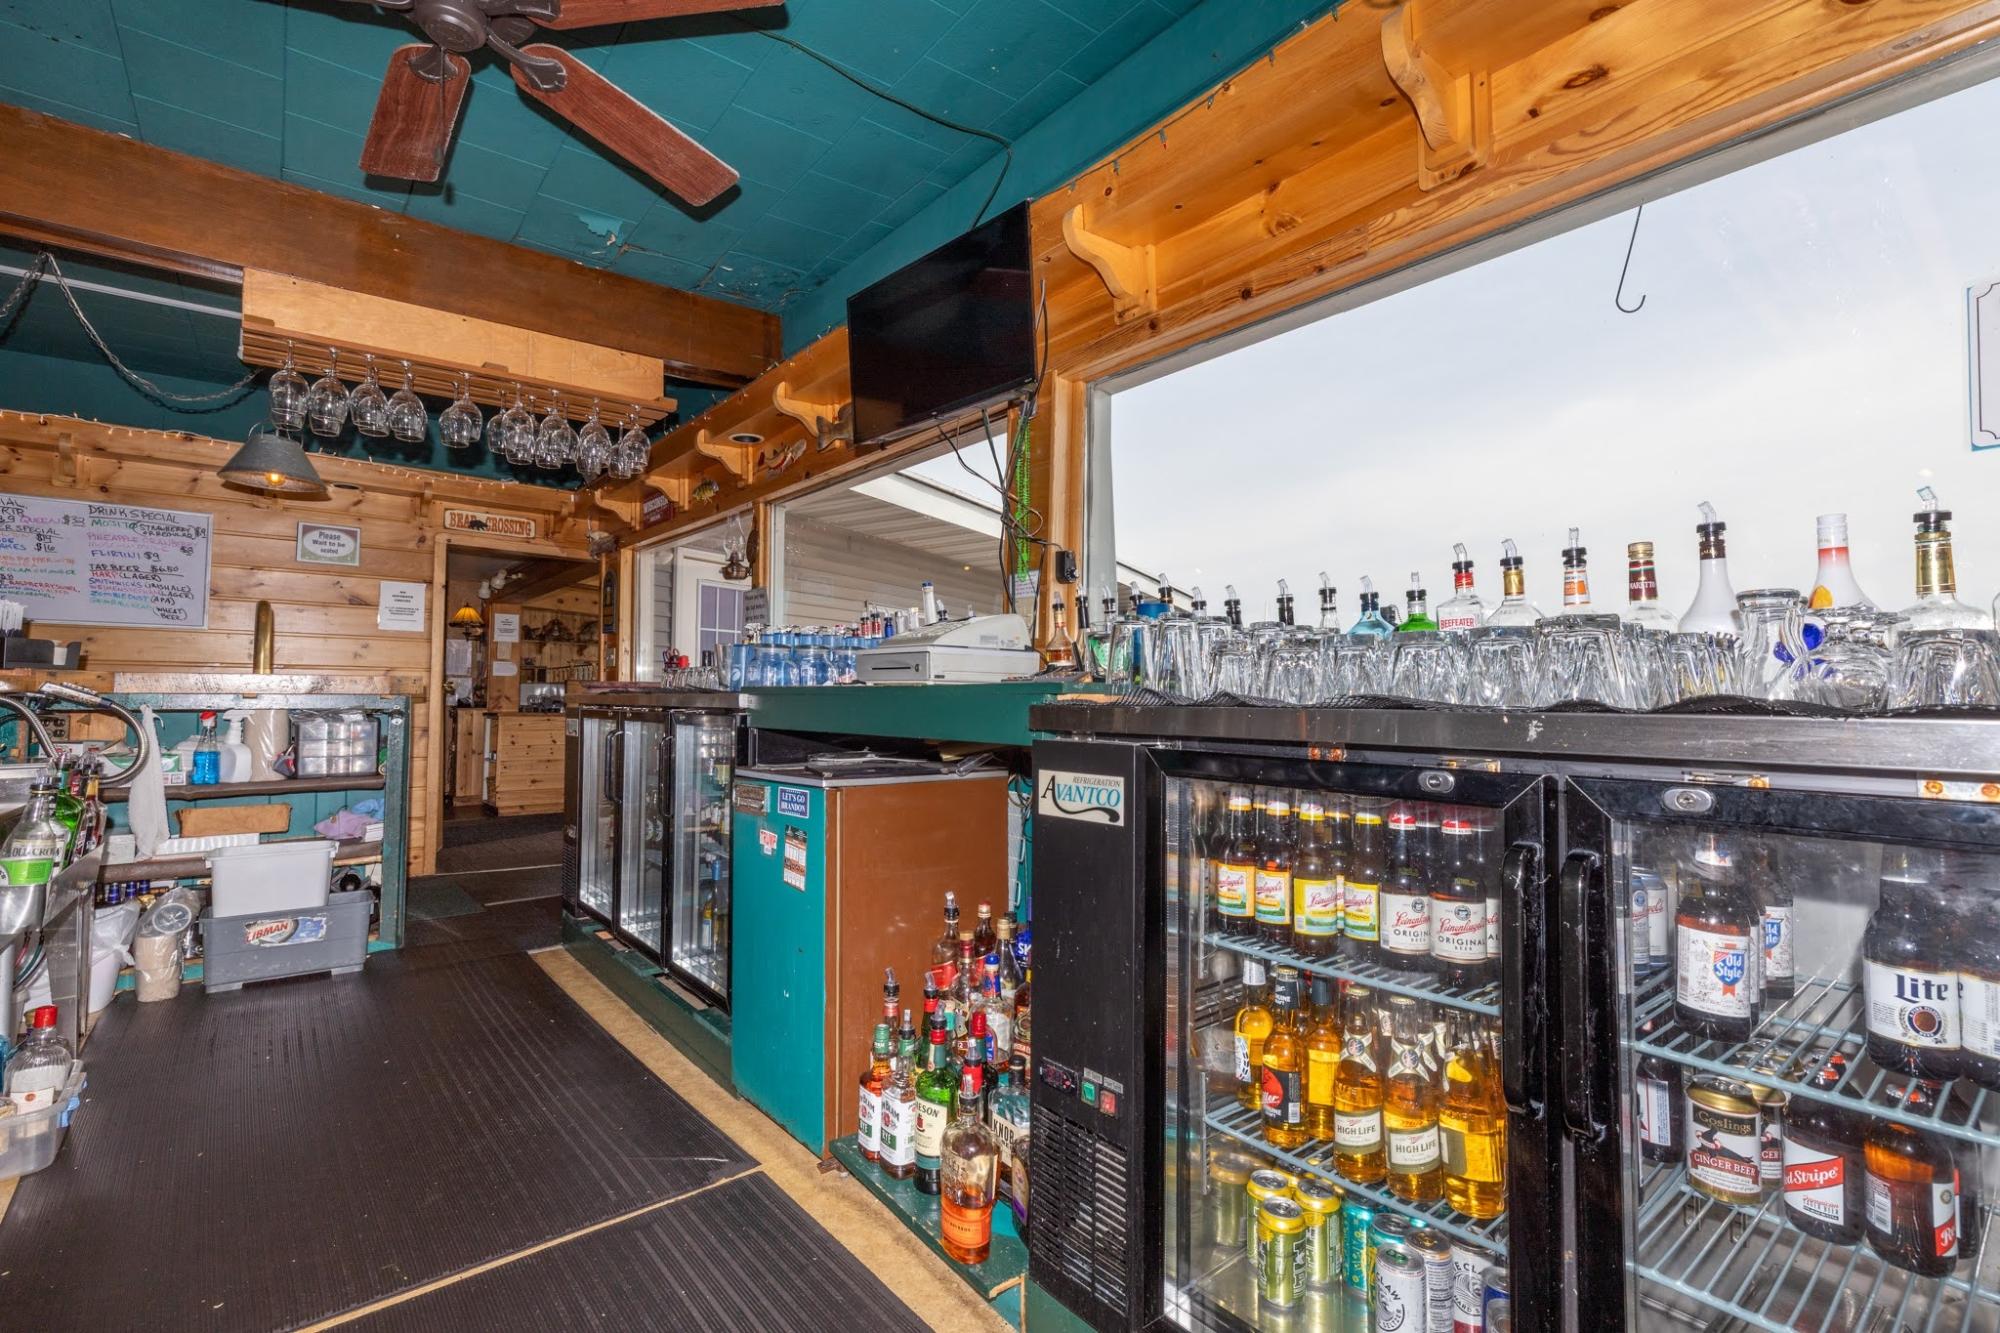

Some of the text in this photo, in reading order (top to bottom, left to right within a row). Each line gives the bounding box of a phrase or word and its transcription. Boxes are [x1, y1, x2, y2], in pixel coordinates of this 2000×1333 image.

[88, 505, 179, 524] DRINK SPECIAL
[485, 516, 531, 536] CROSSING
[319, 531, 341, 541] Please
[1440, 617, 1475, 630] BEEFEATER
[1072, 775, 1121, 788] REFRIGERATION
[782, 792, 806, 803] LET'S GO
[1041, 775, 1121, 812] AVANTCO
[780, 801, 806, 813] BRANDON
[242, 922, 289, 944] LIBMAN
[1726, 953, 1742, 967] Old
[1716, 961, 1743, 983] Style
[1894, 973, 1949, 1005] Lite
[993, 1118, 1015, 1145] KNOB
[1337, 1124, 1377, 1135] HIGH LIFE
[1698, 1110, 1752, 1135] Goslings
[1395, 1140, 1437, 1154] HIGH LIFE
[1694, 1152, 1732, 1170] GINGER
[1734, 1163, 1756, 1177] BEER
[1794, 1168, 1838, 1185] Stripe
